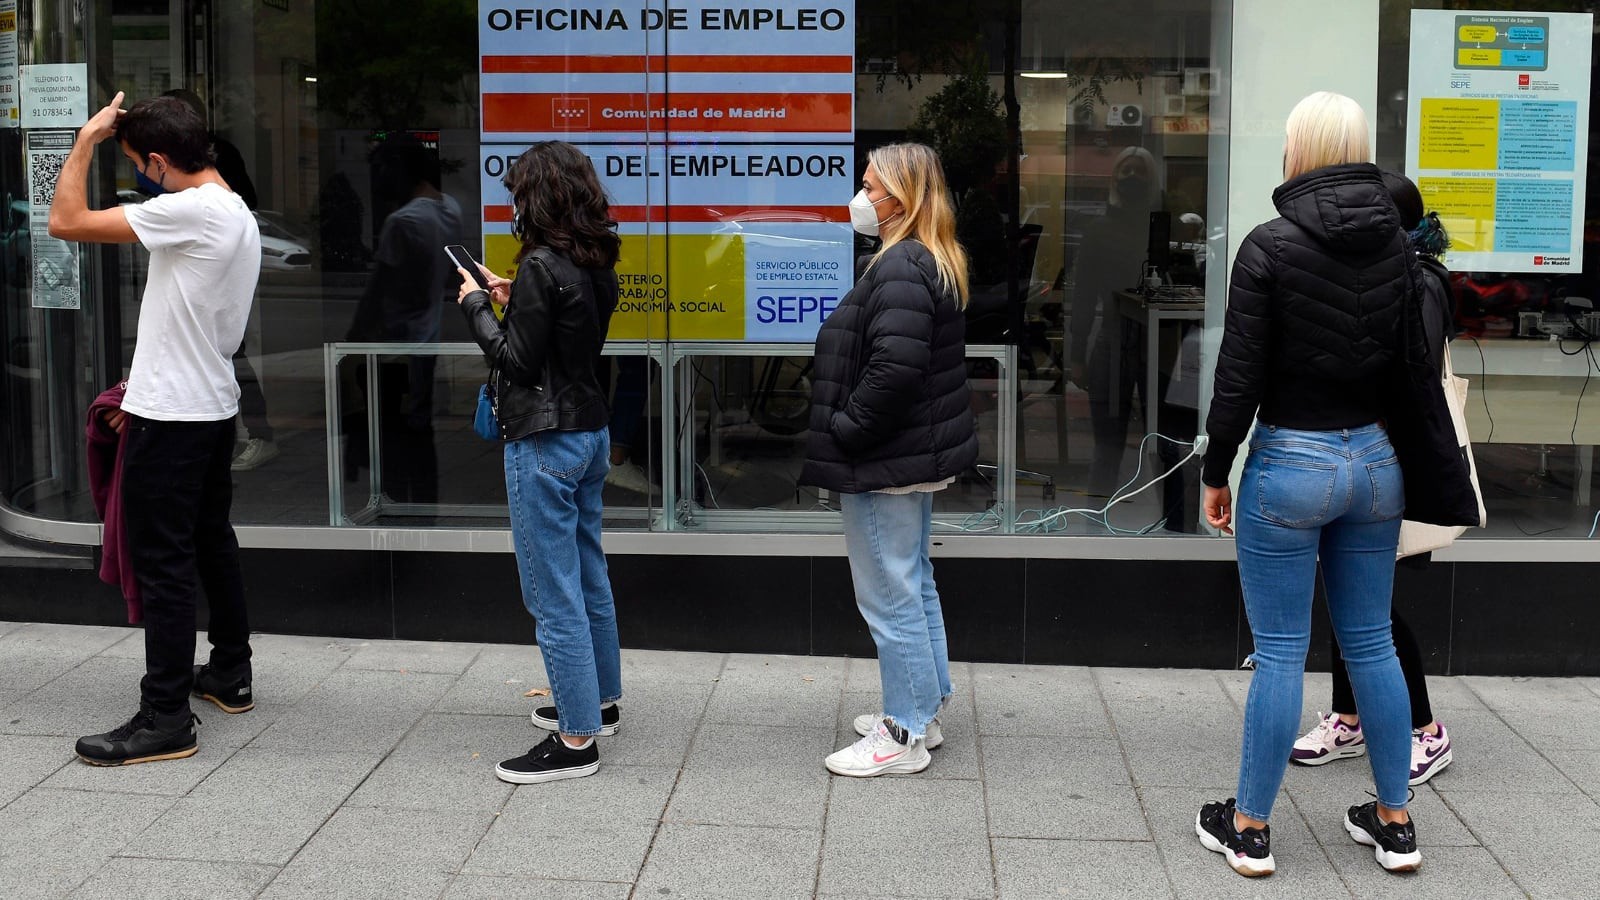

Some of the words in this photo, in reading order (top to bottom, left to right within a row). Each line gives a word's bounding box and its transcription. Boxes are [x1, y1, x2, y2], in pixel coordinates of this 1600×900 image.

[487, 8, 629, 31] OFICINA
[640, 8, 688, 31] DE
[701, 8, 845, 31] EMPLEO
[1450, 81, 1471, 89] SEPE
[32, 108, 41, 117] 91
[42, 108, 73, 117] 0783454
[601, 107, 698, 118] Comunidad
[703, 107, 723, 118] de
[729, 107, 786, 118] Madrid
[606, 155, 660, 177] DEL
[670, 155, 846, 177] EMPLEADOR
[756, 261, 797, 270] SERVICIO
[799, 259, 839, 270] PÚBLICO
[618, 274, 663, 285] STERIO
[756, 272, 768, 281] DE
[769, 272, 803, 281] EMPLEO
[804, 272, 839, 281] ESTATAL
[617, 288, 667, 301] RABAJO
[680, 301, 726, 313] SOCIAL
[756, 295, 838, 324] SEPE
